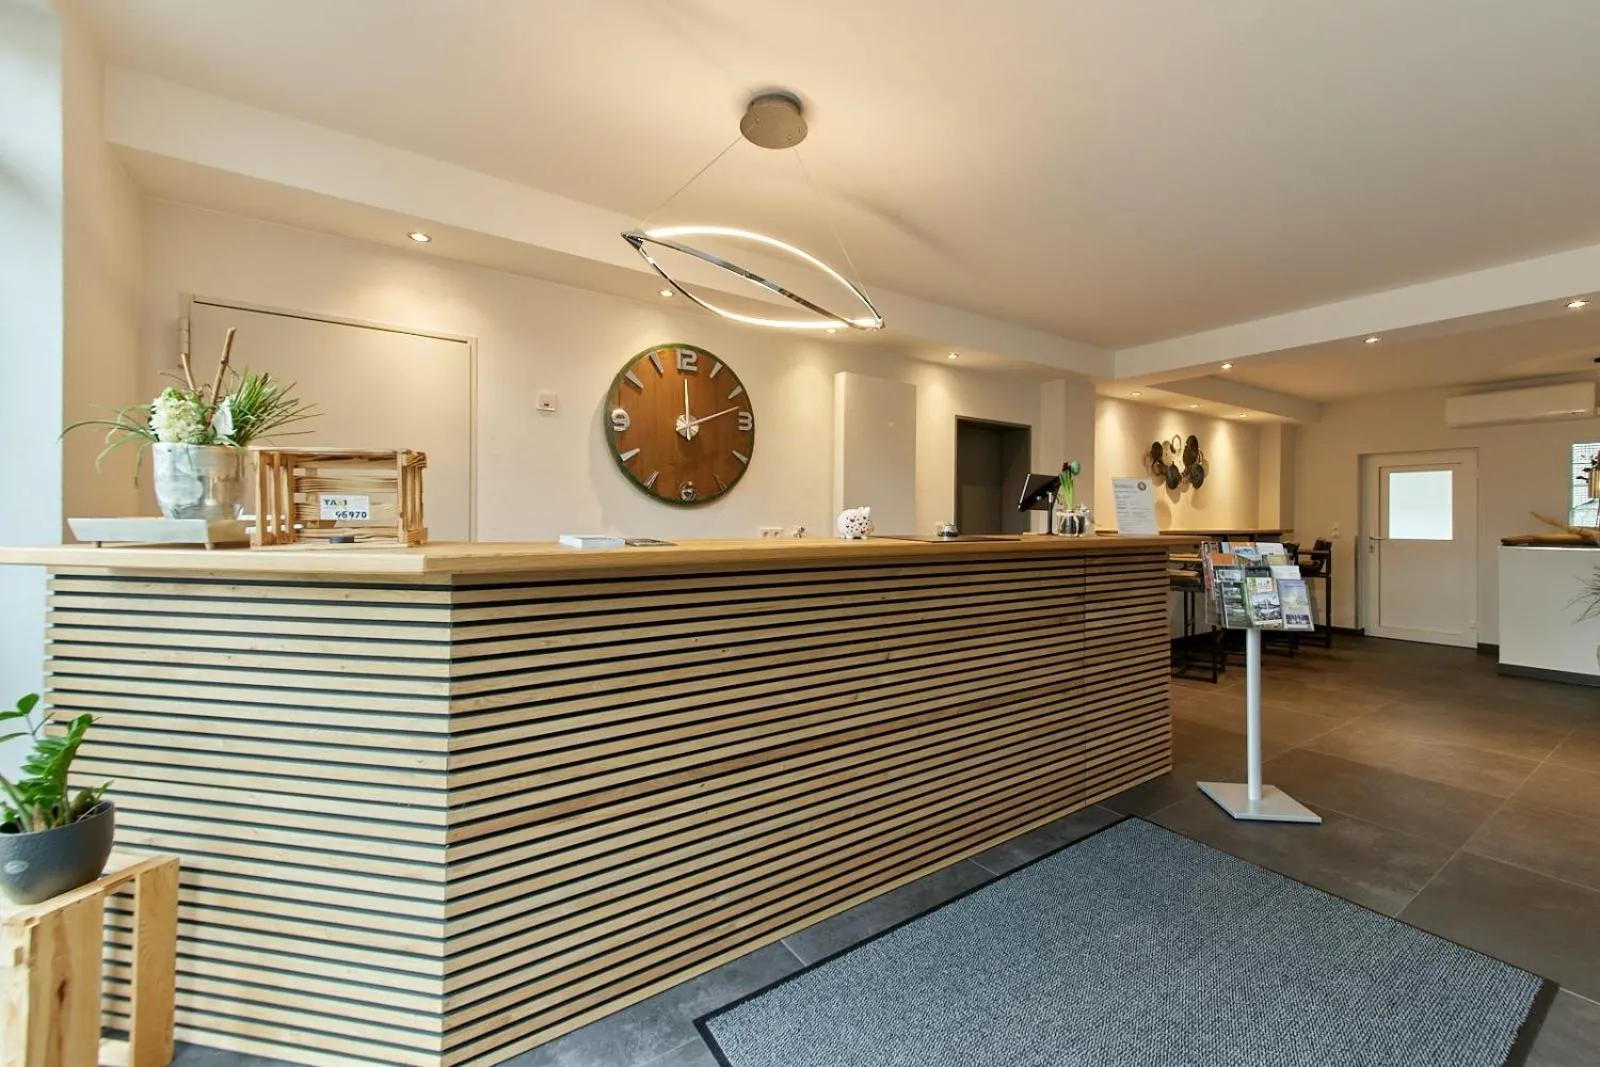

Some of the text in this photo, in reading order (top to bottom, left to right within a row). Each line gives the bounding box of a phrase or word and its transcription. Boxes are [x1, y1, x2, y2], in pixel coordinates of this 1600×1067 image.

[676, 349, 698, 371] 12
[611, 408, 630, 432] 9
[738, 411, 753, 431] 3
[680, 481, 697, 501] 6
